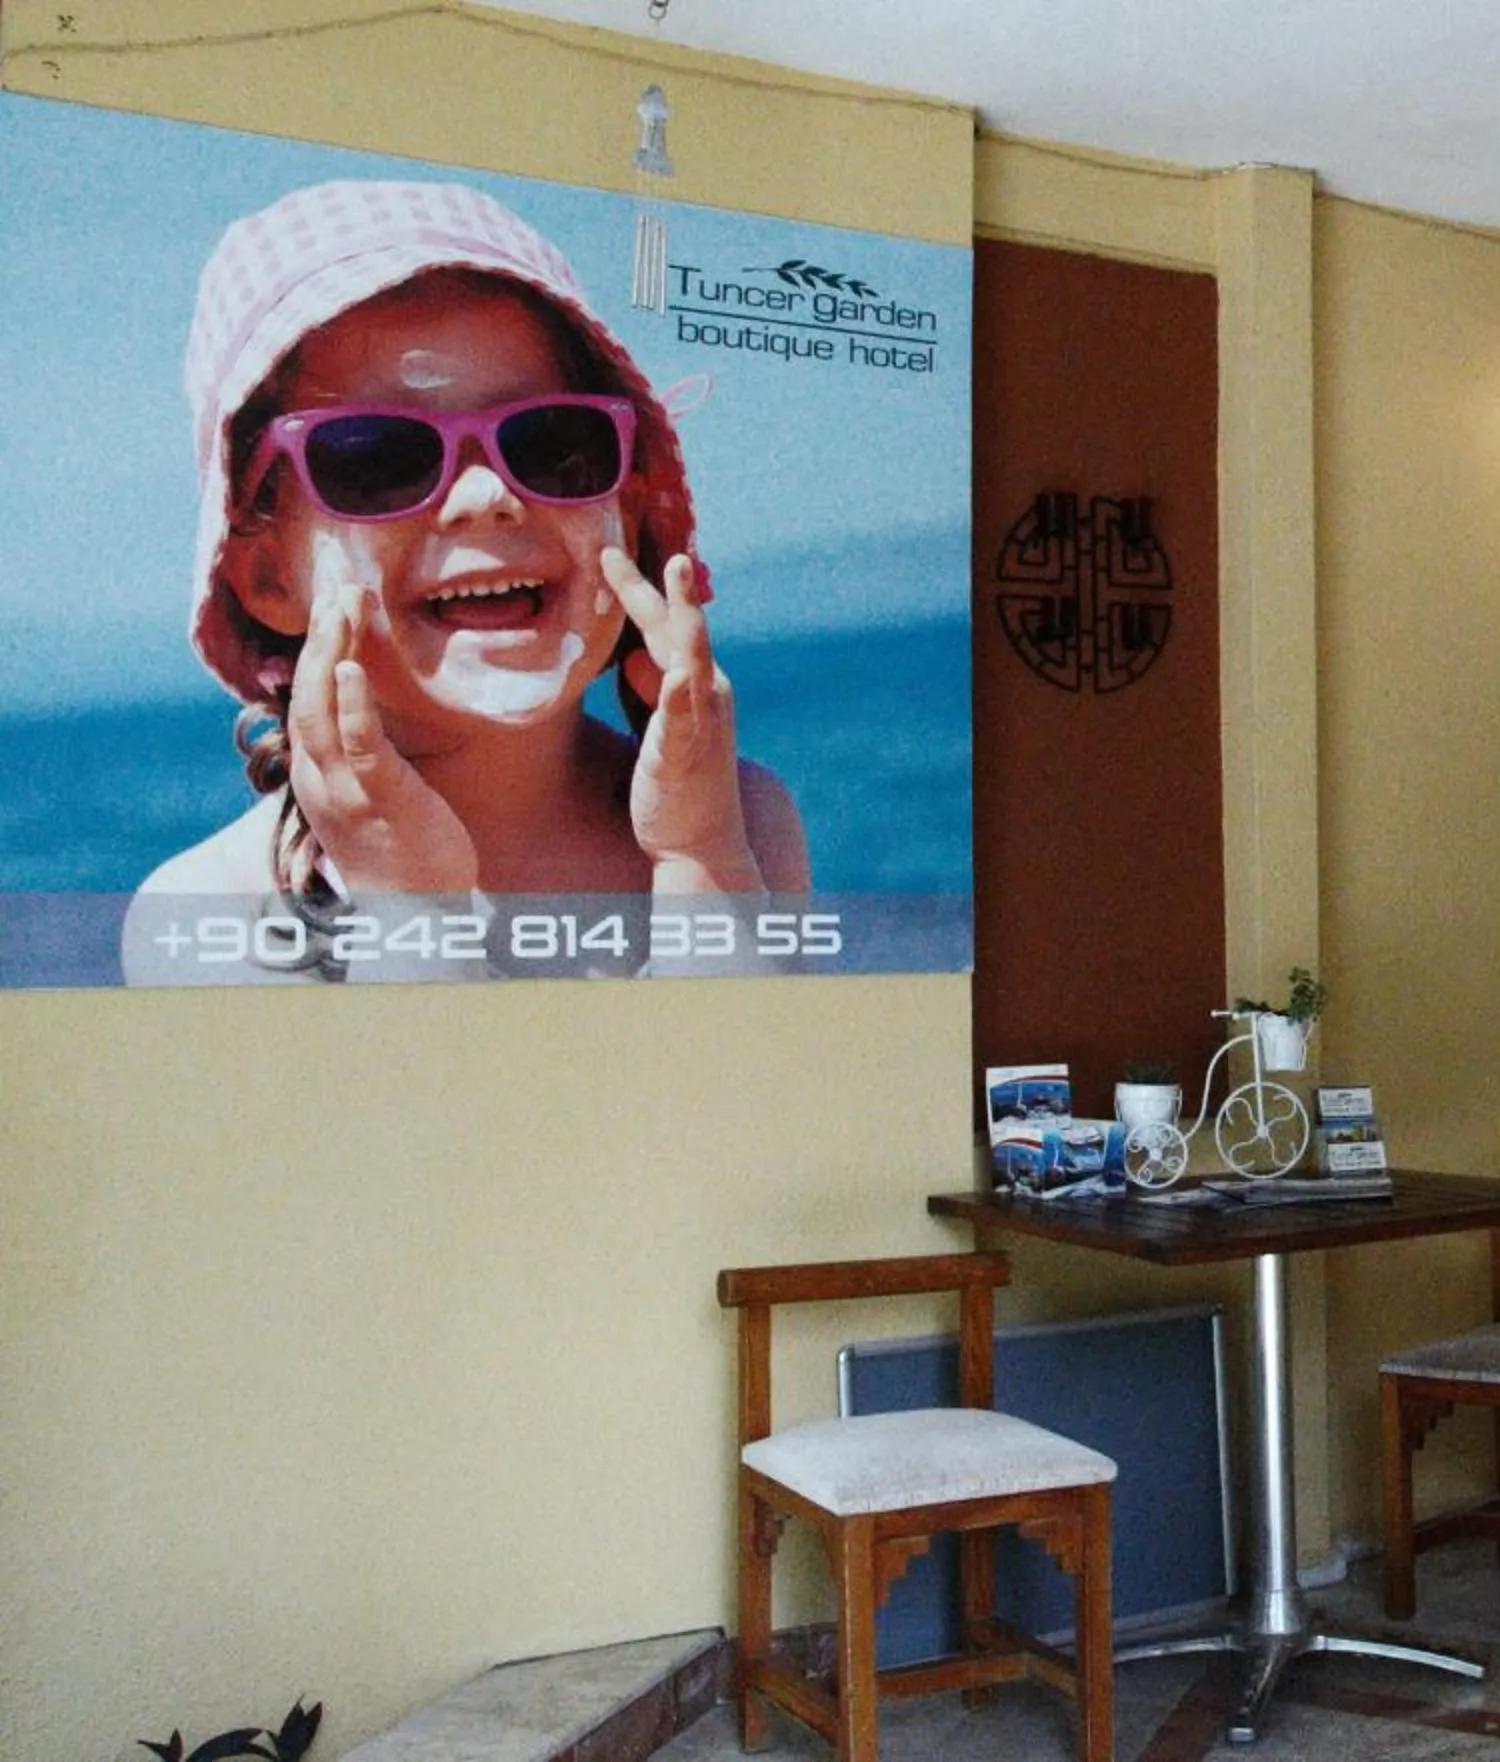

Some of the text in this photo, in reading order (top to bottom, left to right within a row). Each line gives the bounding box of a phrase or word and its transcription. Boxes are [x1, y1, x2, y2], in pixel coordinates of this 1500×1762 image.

[667, 264, 937, 331] Tuncer garden
[677, 315, 934, 373] boutique hotel
[155, 913, 842, 962] +90 242 814 33 55
